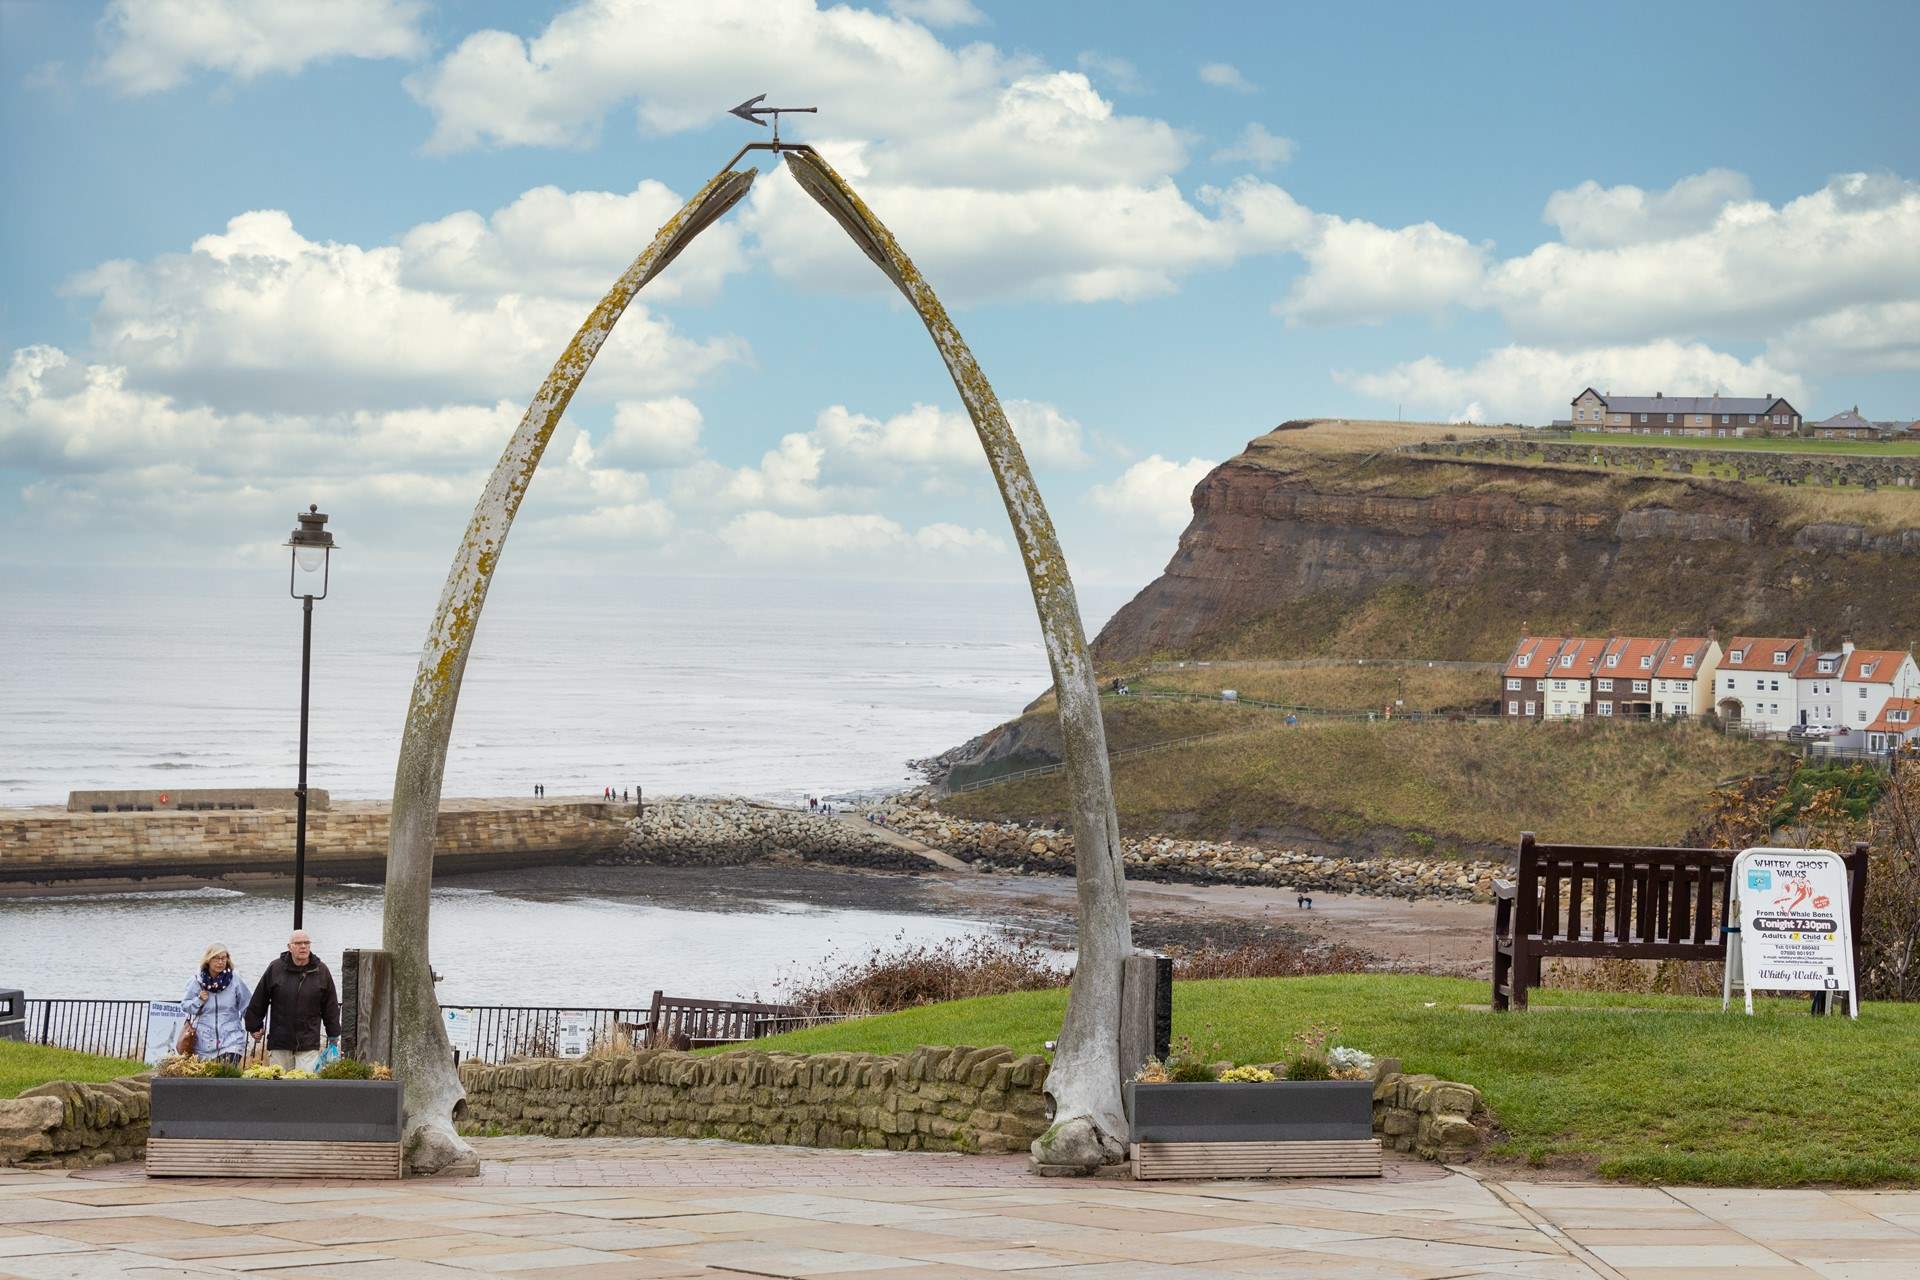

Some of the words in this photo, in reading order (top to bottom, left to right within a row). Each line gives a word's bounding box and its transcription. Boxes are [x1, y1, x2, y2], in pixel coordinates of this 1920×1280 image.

[1754, 859, 1791, 868] WHITBY
[1796, 861, 1830, 870] GHOST
[1776, 869, 1807, 878] WALKS
[1759, 919, 1795, 931] Tonight
[1796, 920, 1831, 932] 7.30pm
[1758, 969, 1791, 982] Whitby
[1792, 970, 1823, 981] Walks
